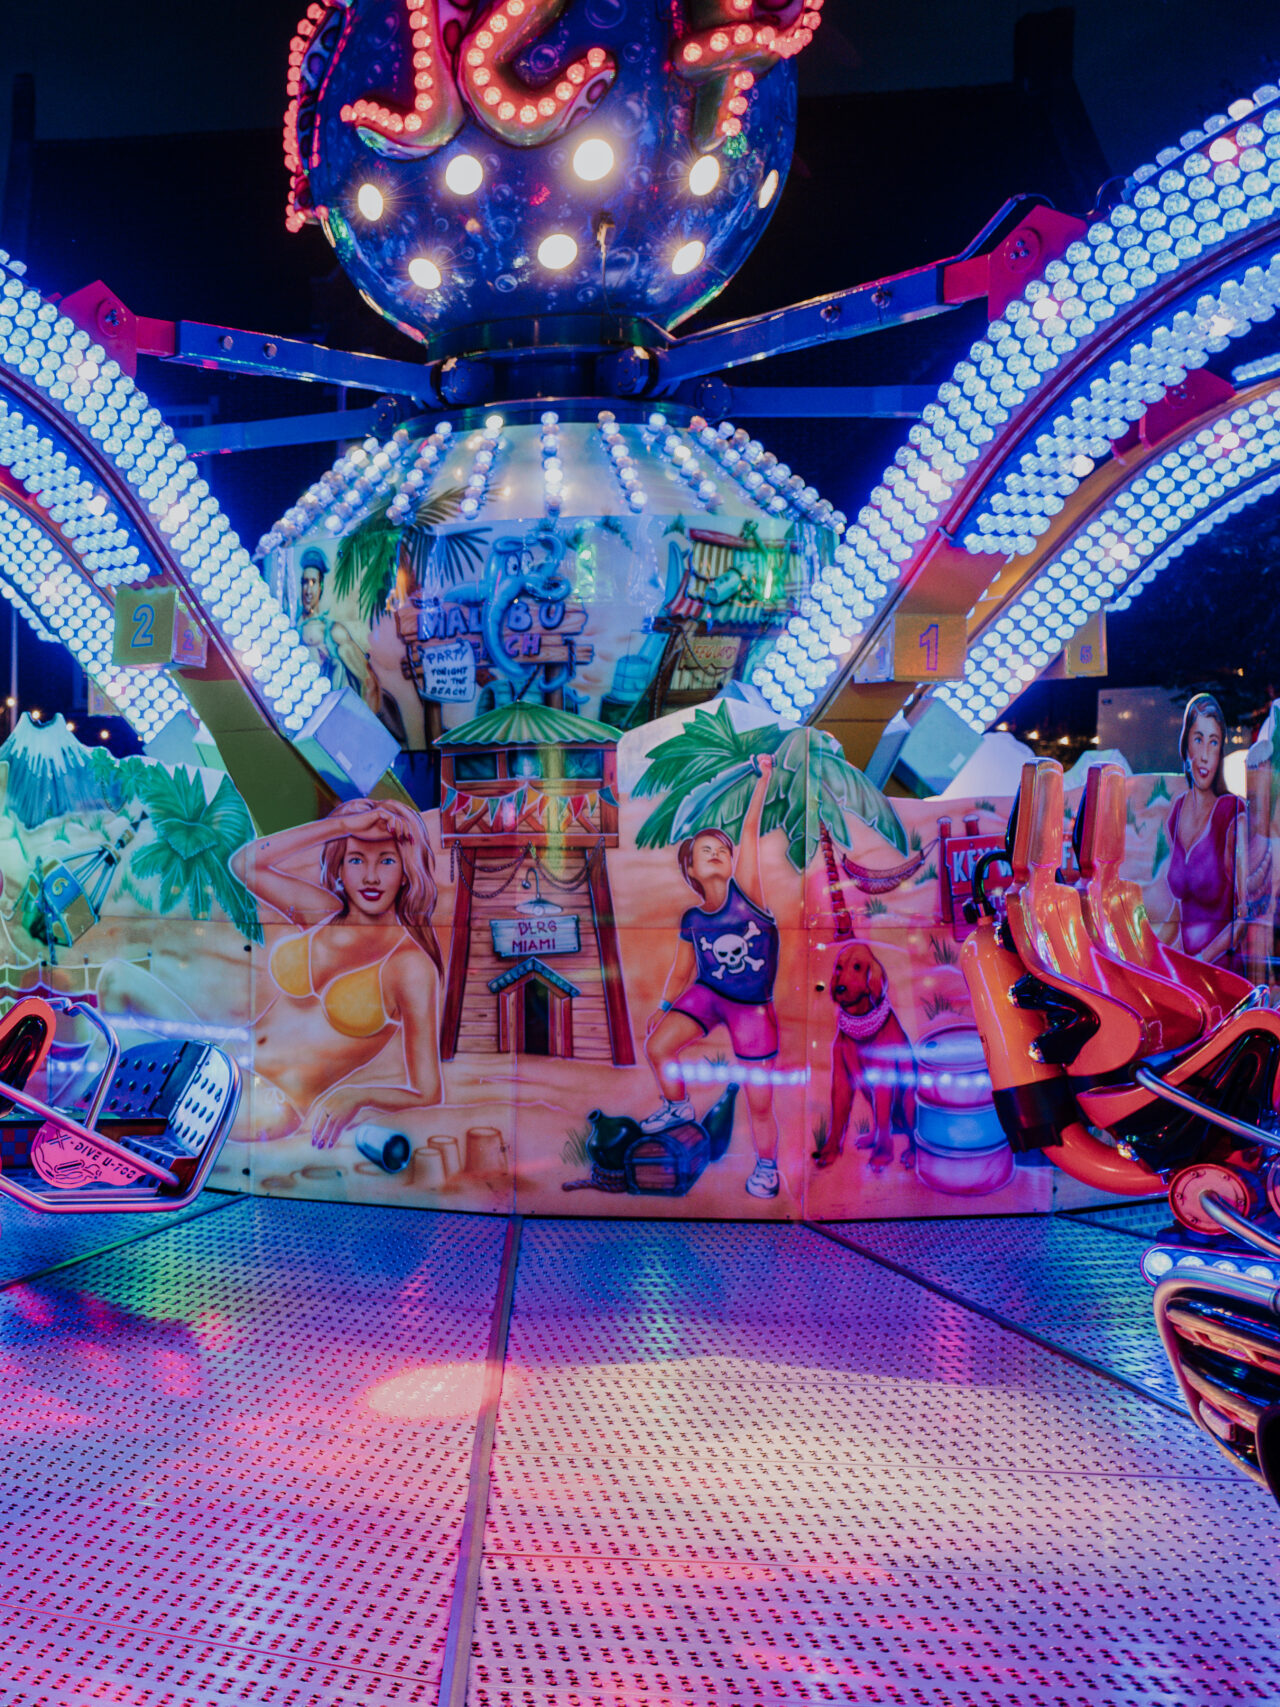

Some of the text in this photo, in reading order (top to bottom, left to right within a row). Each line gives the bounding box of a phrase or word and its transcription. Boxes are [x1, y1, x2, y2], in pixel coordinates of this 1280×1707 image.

[131, 604, 156, 649] 2
[417, 599, 566, 641] MALBU
[183, 629, 194, 651] 2
[919, 623, 939, 671] 1
[426, 647, 468, 664] PARTY
[1079, 645, 1093, 664] 5
[431, 666, 468, 676] TONIGHT
[430, 686, 468, 696] BEACH
[517, 920, 558, 936] DLRG
[511, 938, 556, 953] MIAMI
